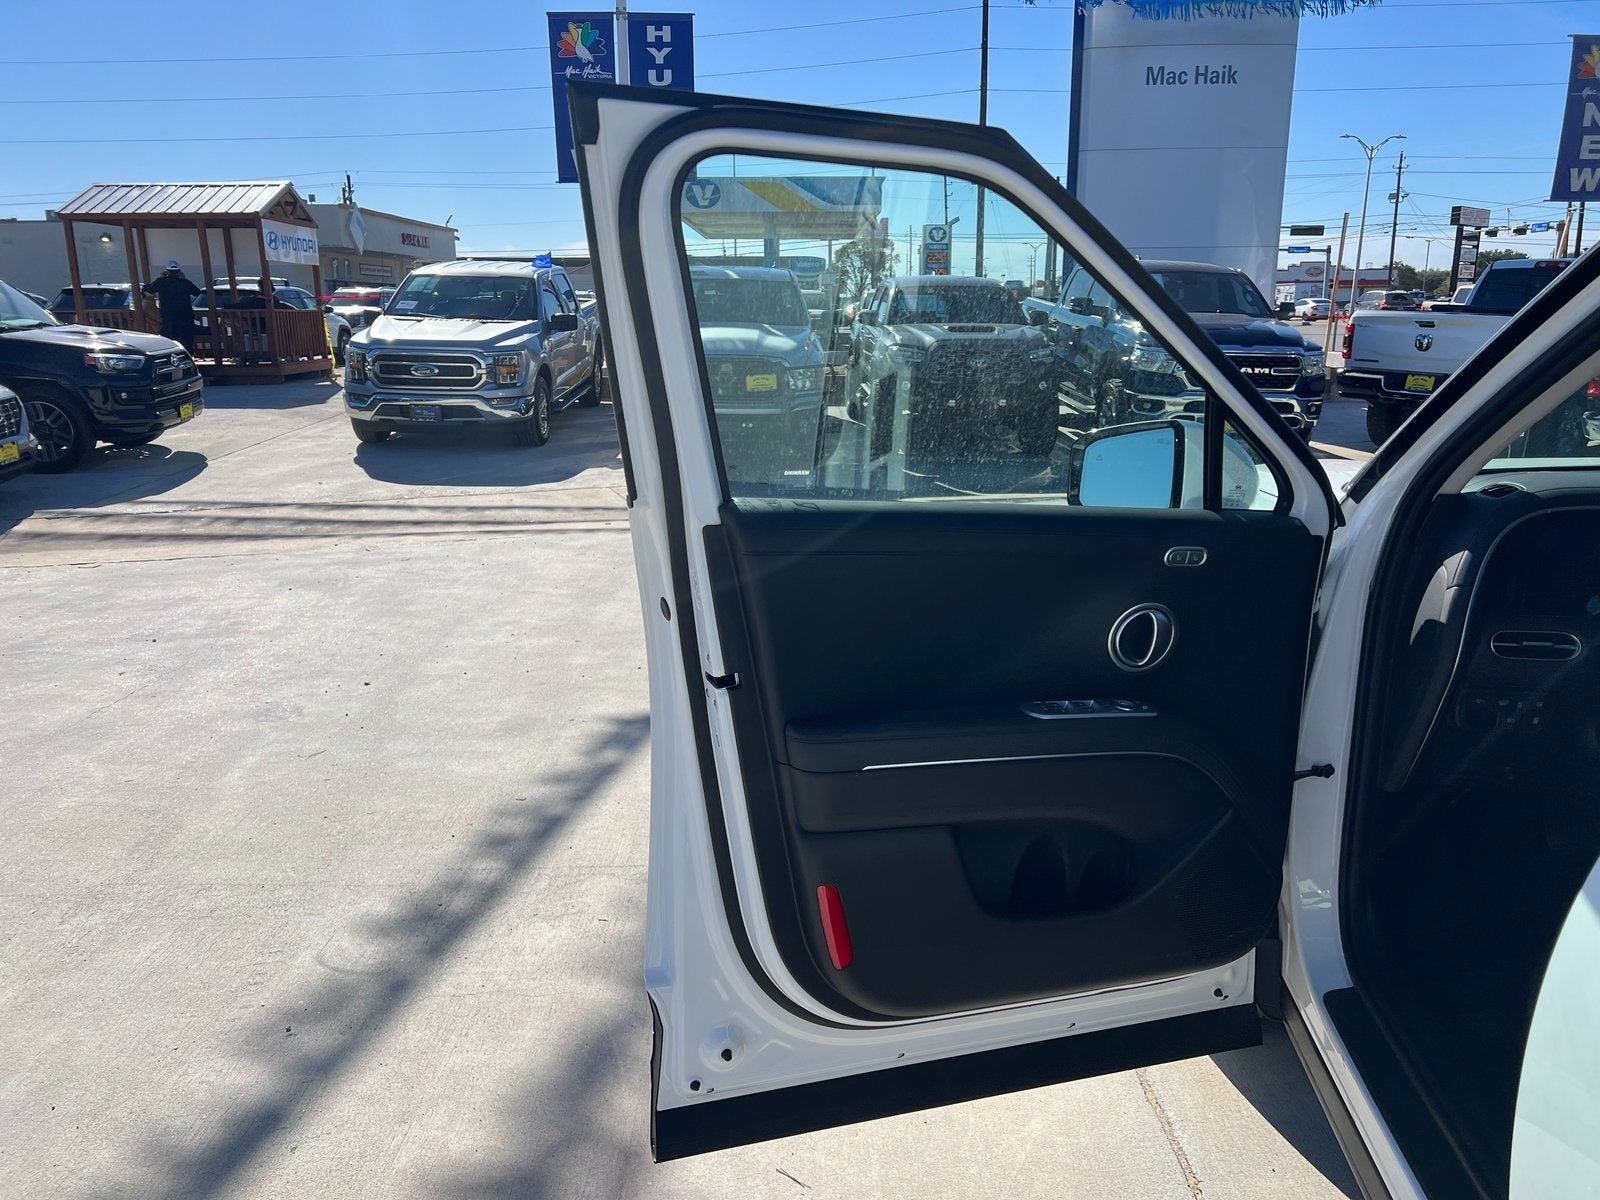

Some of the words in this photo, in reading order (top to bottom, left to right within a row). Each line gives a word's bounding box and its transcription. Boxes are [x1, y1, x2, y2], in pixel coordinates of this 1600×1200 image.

[646, 25, 673, 87] HYU
[1145, 66, 1188, 86] Mac
[1194, 64, 1238, 85] Haik
[280, 234, 316, 254] HYUNDAI
